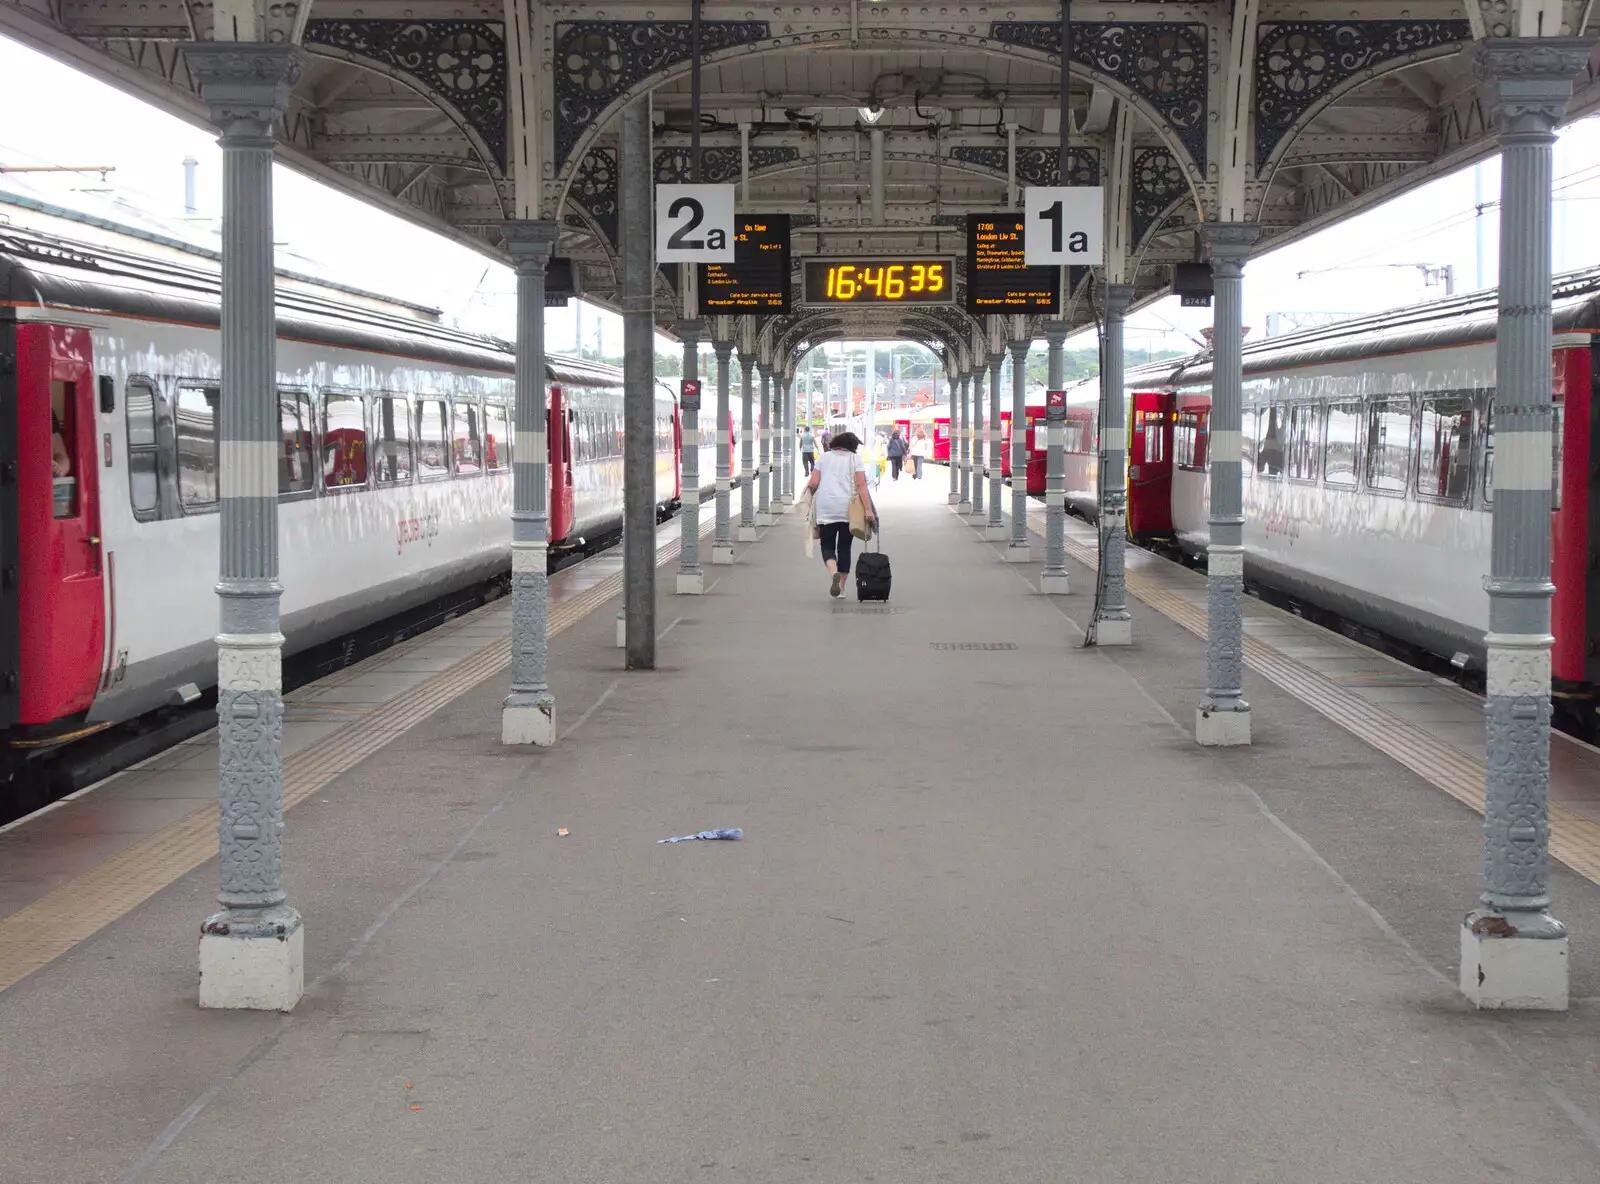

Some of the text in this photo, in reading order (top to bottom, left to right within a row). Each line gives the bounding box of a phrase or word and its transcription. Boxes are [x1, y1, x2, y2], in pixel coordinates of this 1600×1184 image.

[667, 197, 726, 250] 2a
[977, 223, 994, 231] 17:00
[1039, 200, 1088, 253] 1a
[827, 265, 943, 298] 16:46 35
